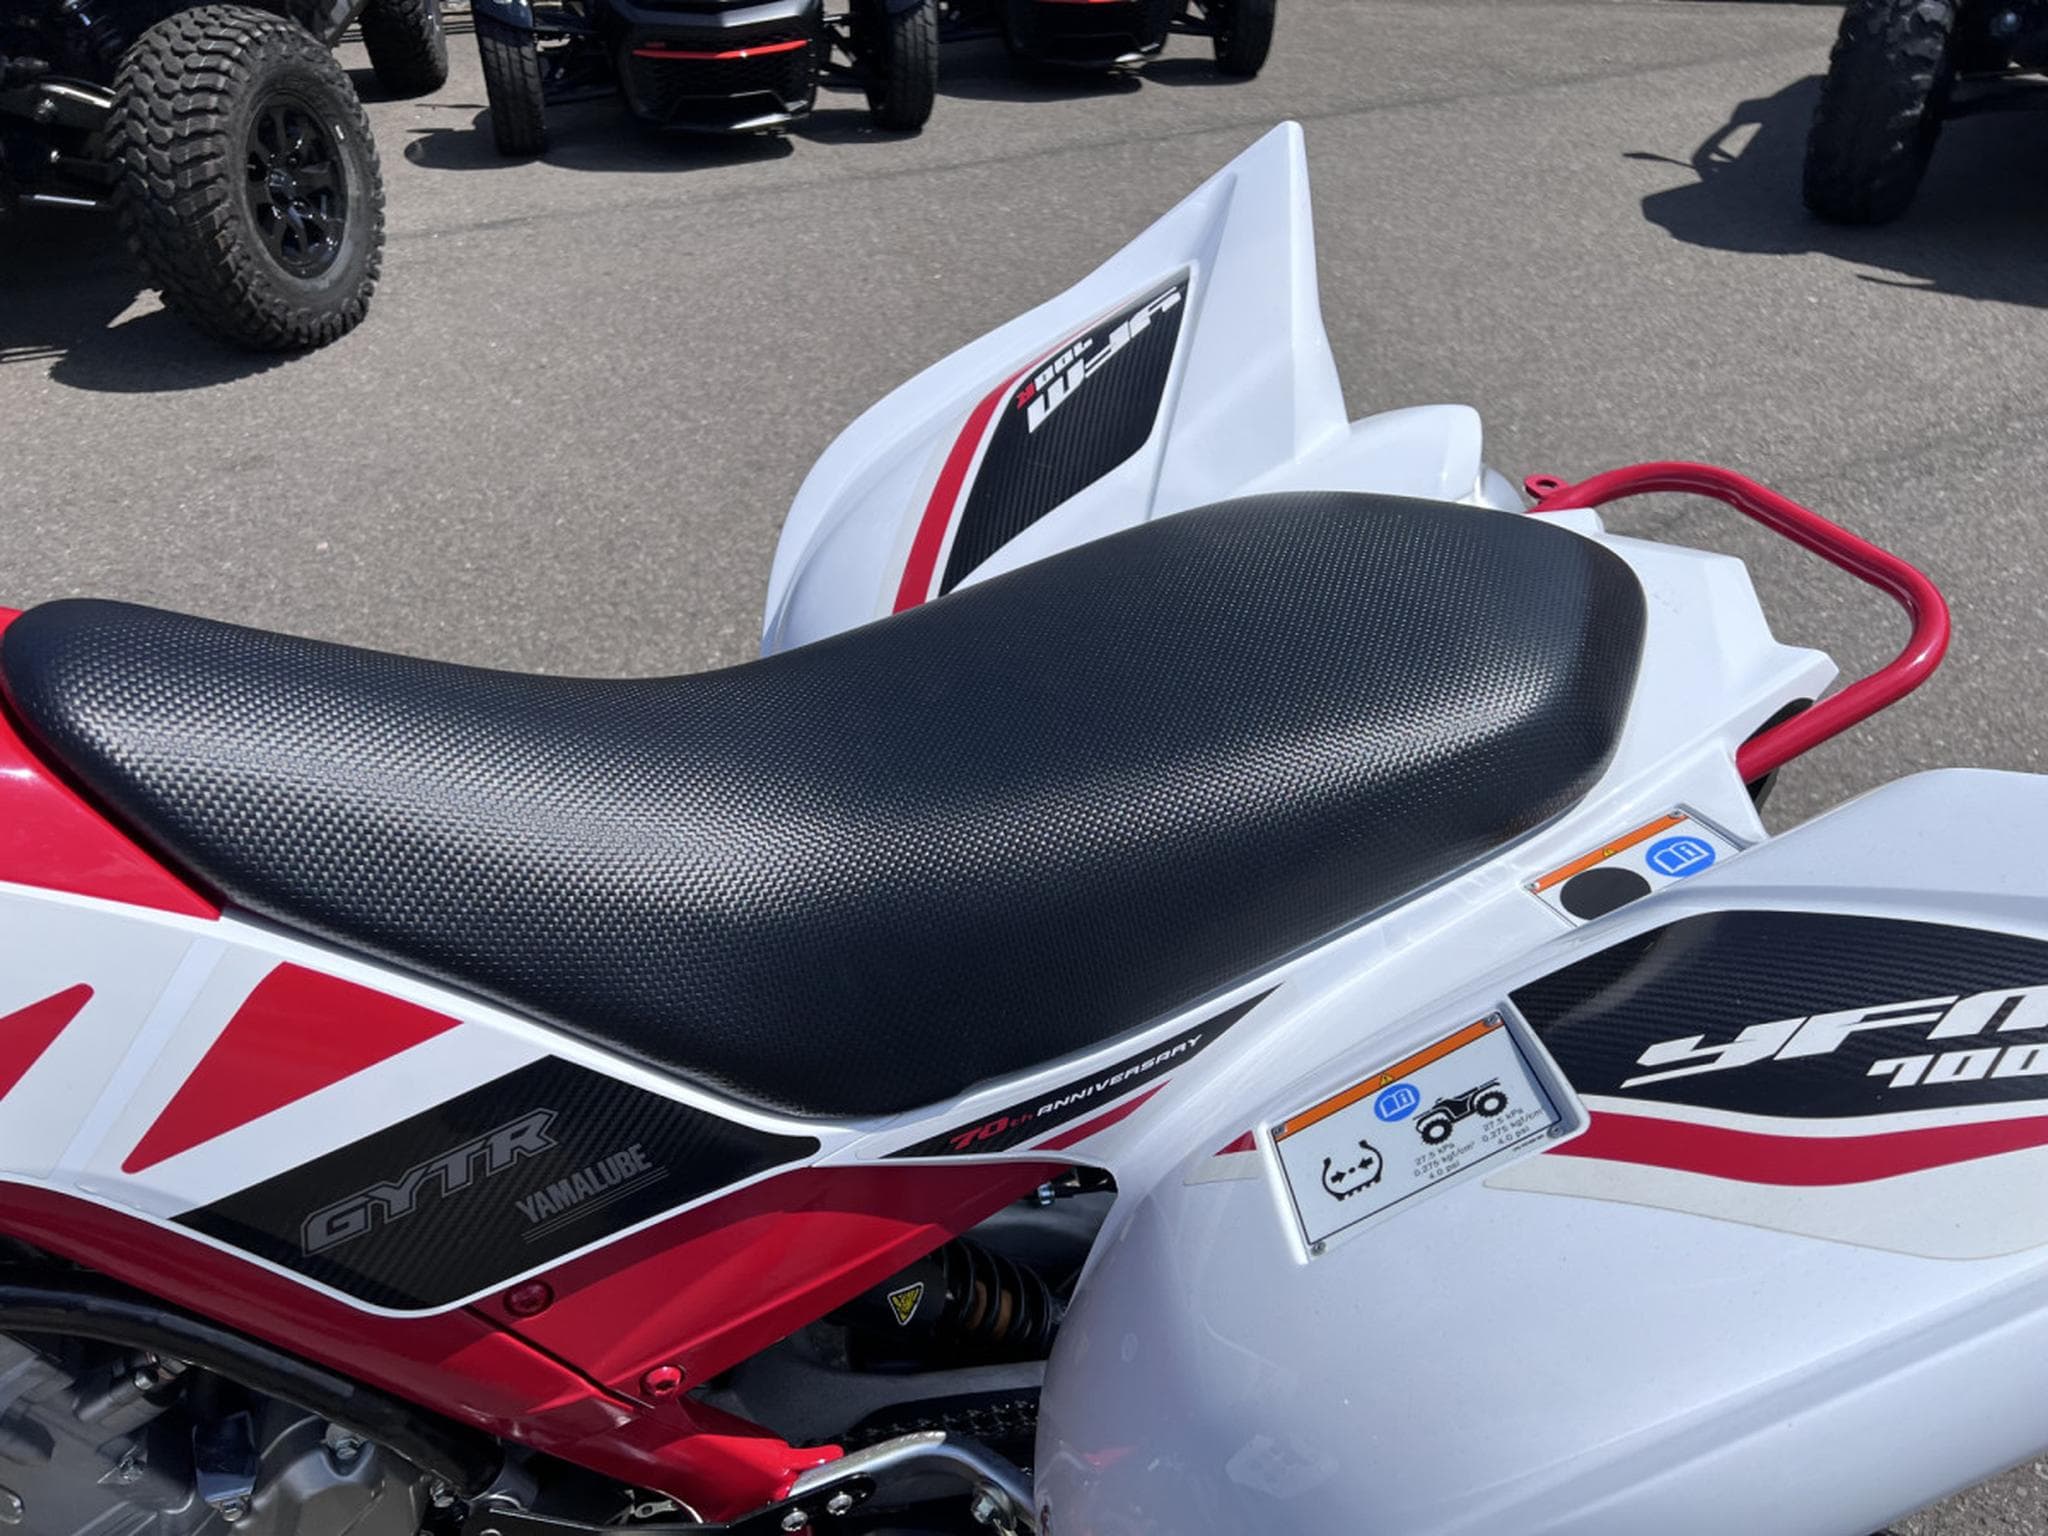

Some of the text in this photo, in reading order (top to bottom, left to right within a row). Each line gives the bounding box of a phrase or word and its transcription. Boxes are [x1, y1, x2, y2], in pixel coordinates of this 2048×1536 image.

[1036, 1033, 1203, 1118] ANNIVERSARY
[301, 1107, 560, 1257] GYTR
[515, 1142, 654, 1224] YAMALUBE
